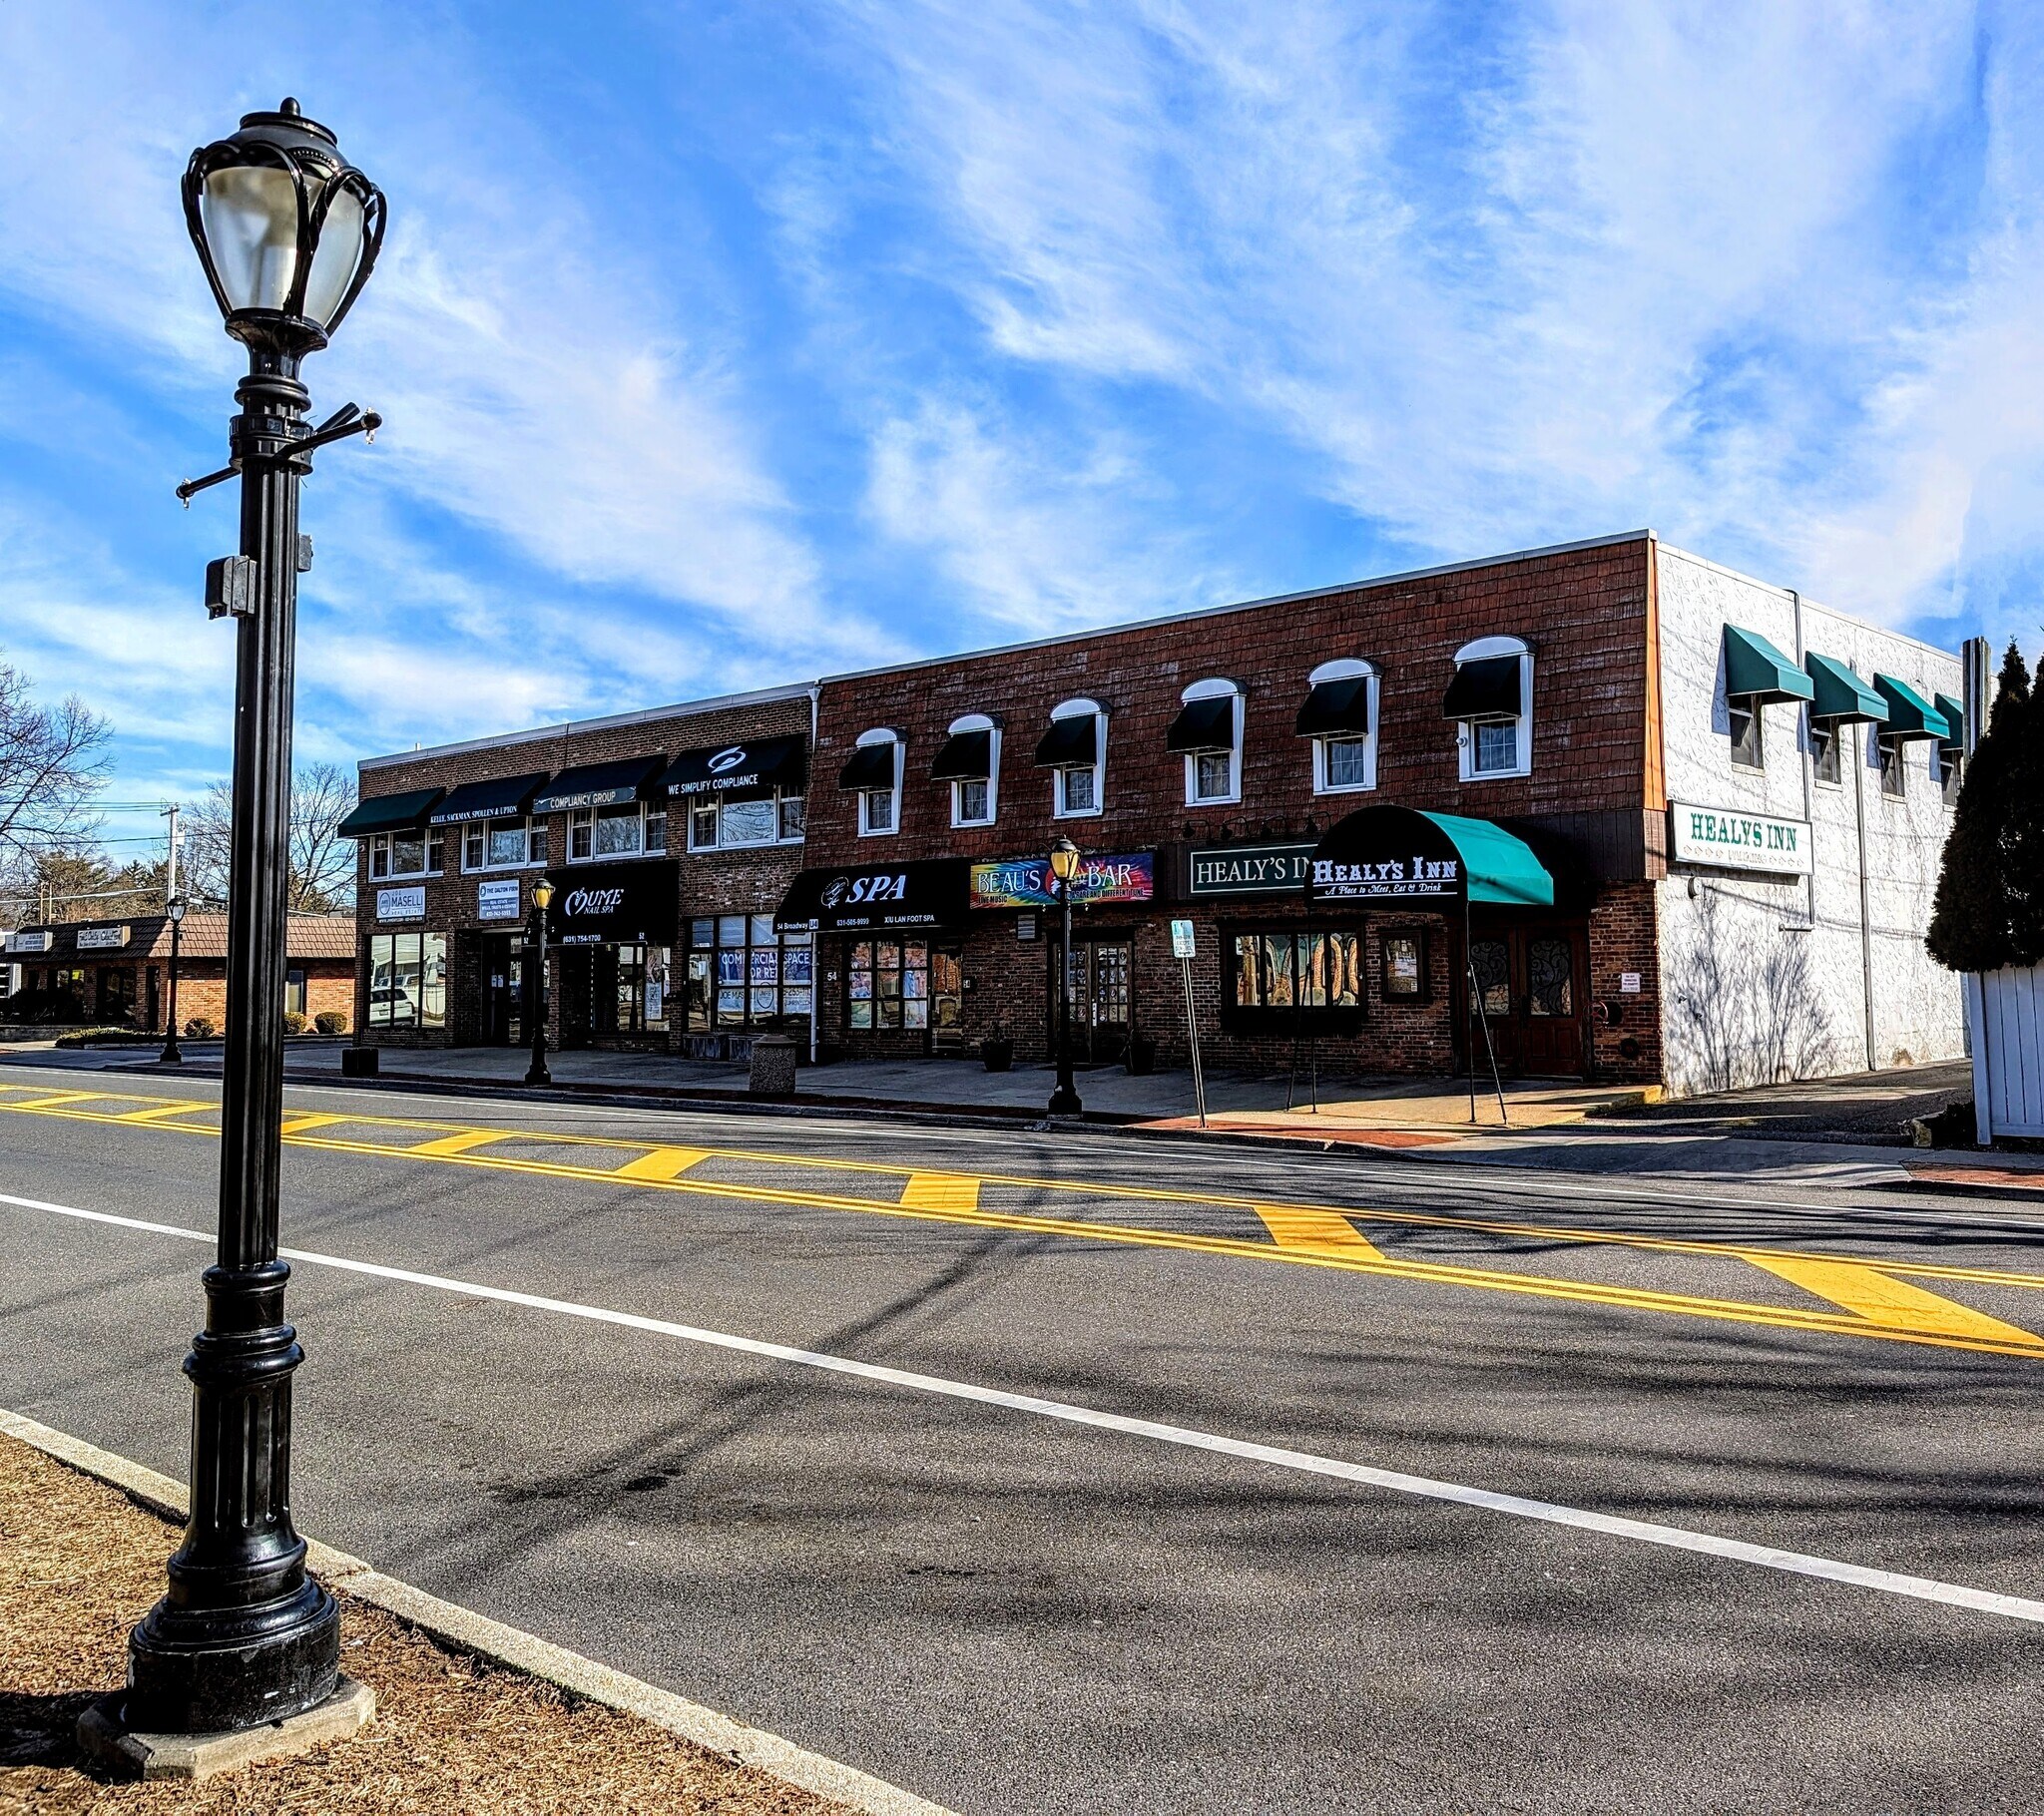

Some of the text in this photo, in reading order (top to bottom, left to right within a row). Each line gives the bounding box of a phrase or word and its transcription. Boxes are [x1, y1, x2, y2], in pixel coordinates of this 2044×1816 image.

[668, 774, 759, 795] WE SIMPLIFY COMPLIANCE
[550, 791, 616, 808] COMPLIANCY GROUP
[1767, 823, 1797, 852] INN
[978, 864, 1133, 893] BEAU'S BAR
[1196, 857, 1286, 884] HEALY'S
[1312, 857, 1457, 883] HEALY'S INN
[845, 875, 907, 903] SPA
[1325, 886, 1336, 895] A
[1338, 886, 1357, 895] Place
[1368, 885, 1391, 894] Meet,
[1393, 884, 1406, 893] Eat
[1408, 884, 1415, 893] &
[1419, 883, 1442, 892] Drink
[392, 895, 423, 907] MASELLI
[783, 953, 809, 964] SPACE
[827, 971, 837, 981] 54
